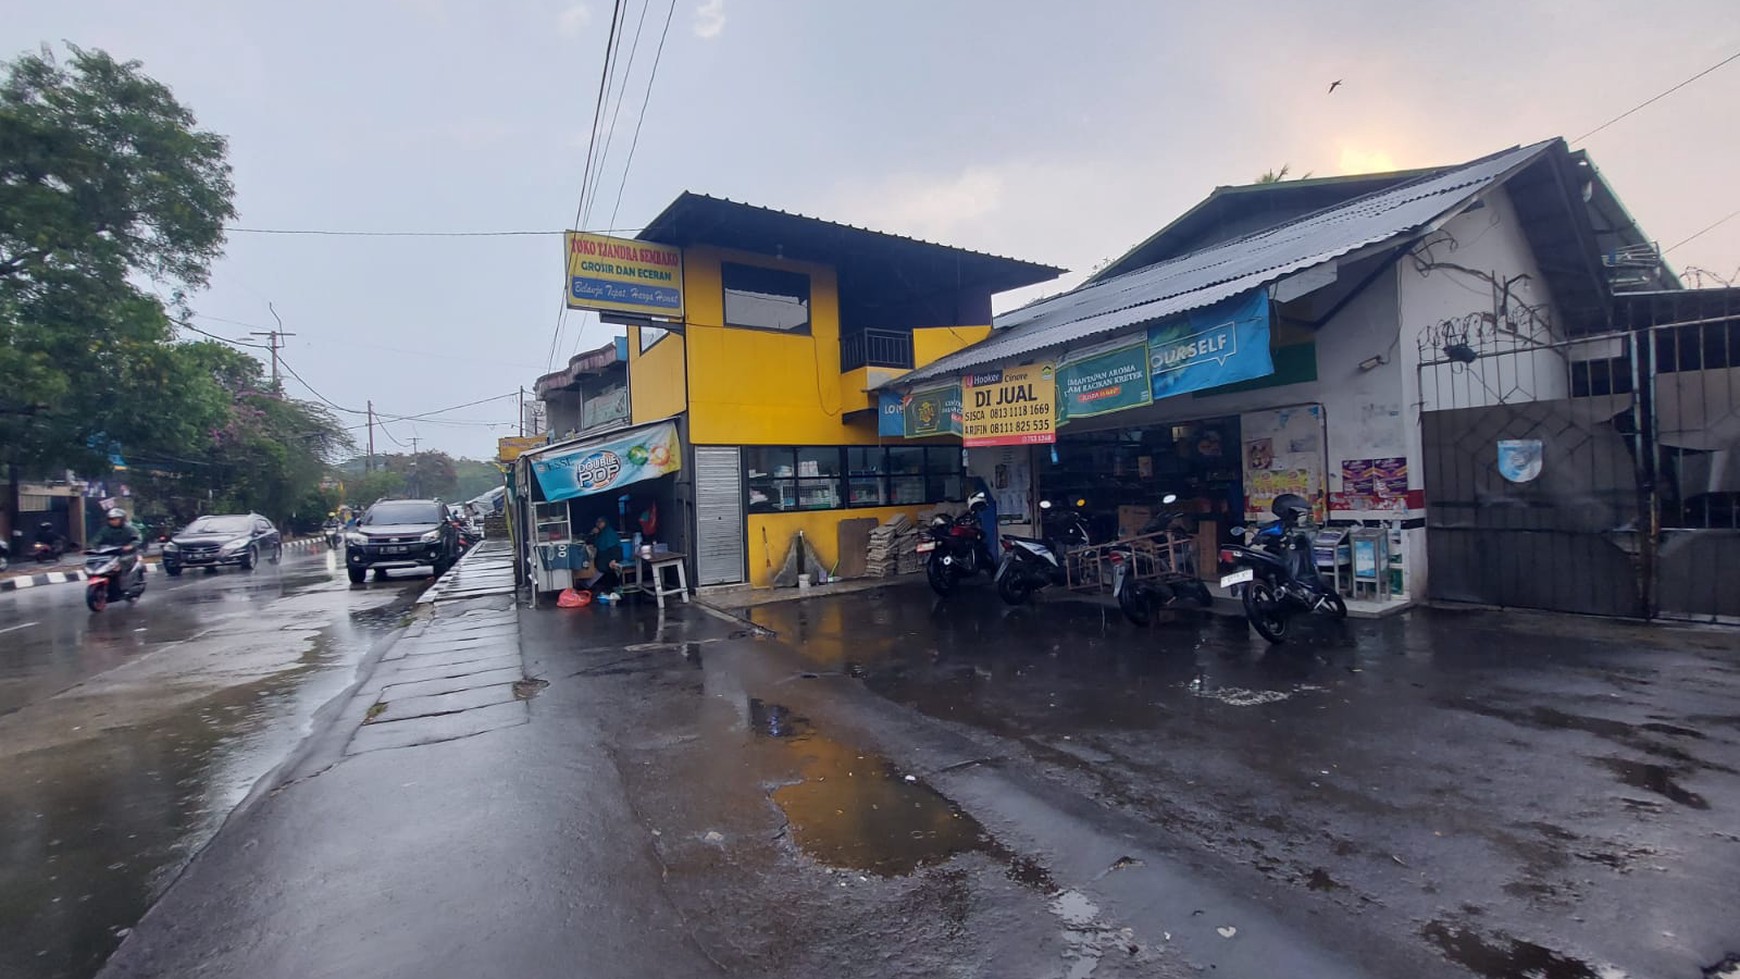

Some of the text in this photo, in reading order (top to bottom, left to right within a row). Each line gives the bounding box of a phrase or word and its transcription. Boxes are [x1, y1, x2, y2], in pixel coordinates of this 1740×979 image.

[571, 239, 679, 267] TOKO TJANDRA SEMBAKO
[581, 261, 671, 281] GROSIR DAN ECERAN
[974, 373, 999, 385] Hooker
[1109, 365, 1136, 377] AROMA
[1083, 380, 1112, 392] RACIKAN
[1114, 371, 1143, 384] KRETEK
[975, 389, 991, 407] DI
[996, 384, 1038, 405] JUAL
[965, 411, 985, 421] SISCA
[990, 408, 1008, 419] 0813
[1010, 406, 1028, 417] 1118
[1030, 403, 1049, 415] 1669
[965, 420, 1049, 435] ARIFIN 08111 825 535
[577, 456, 618, 473] DOUBLE
[579, 465, 620, 488] POP
